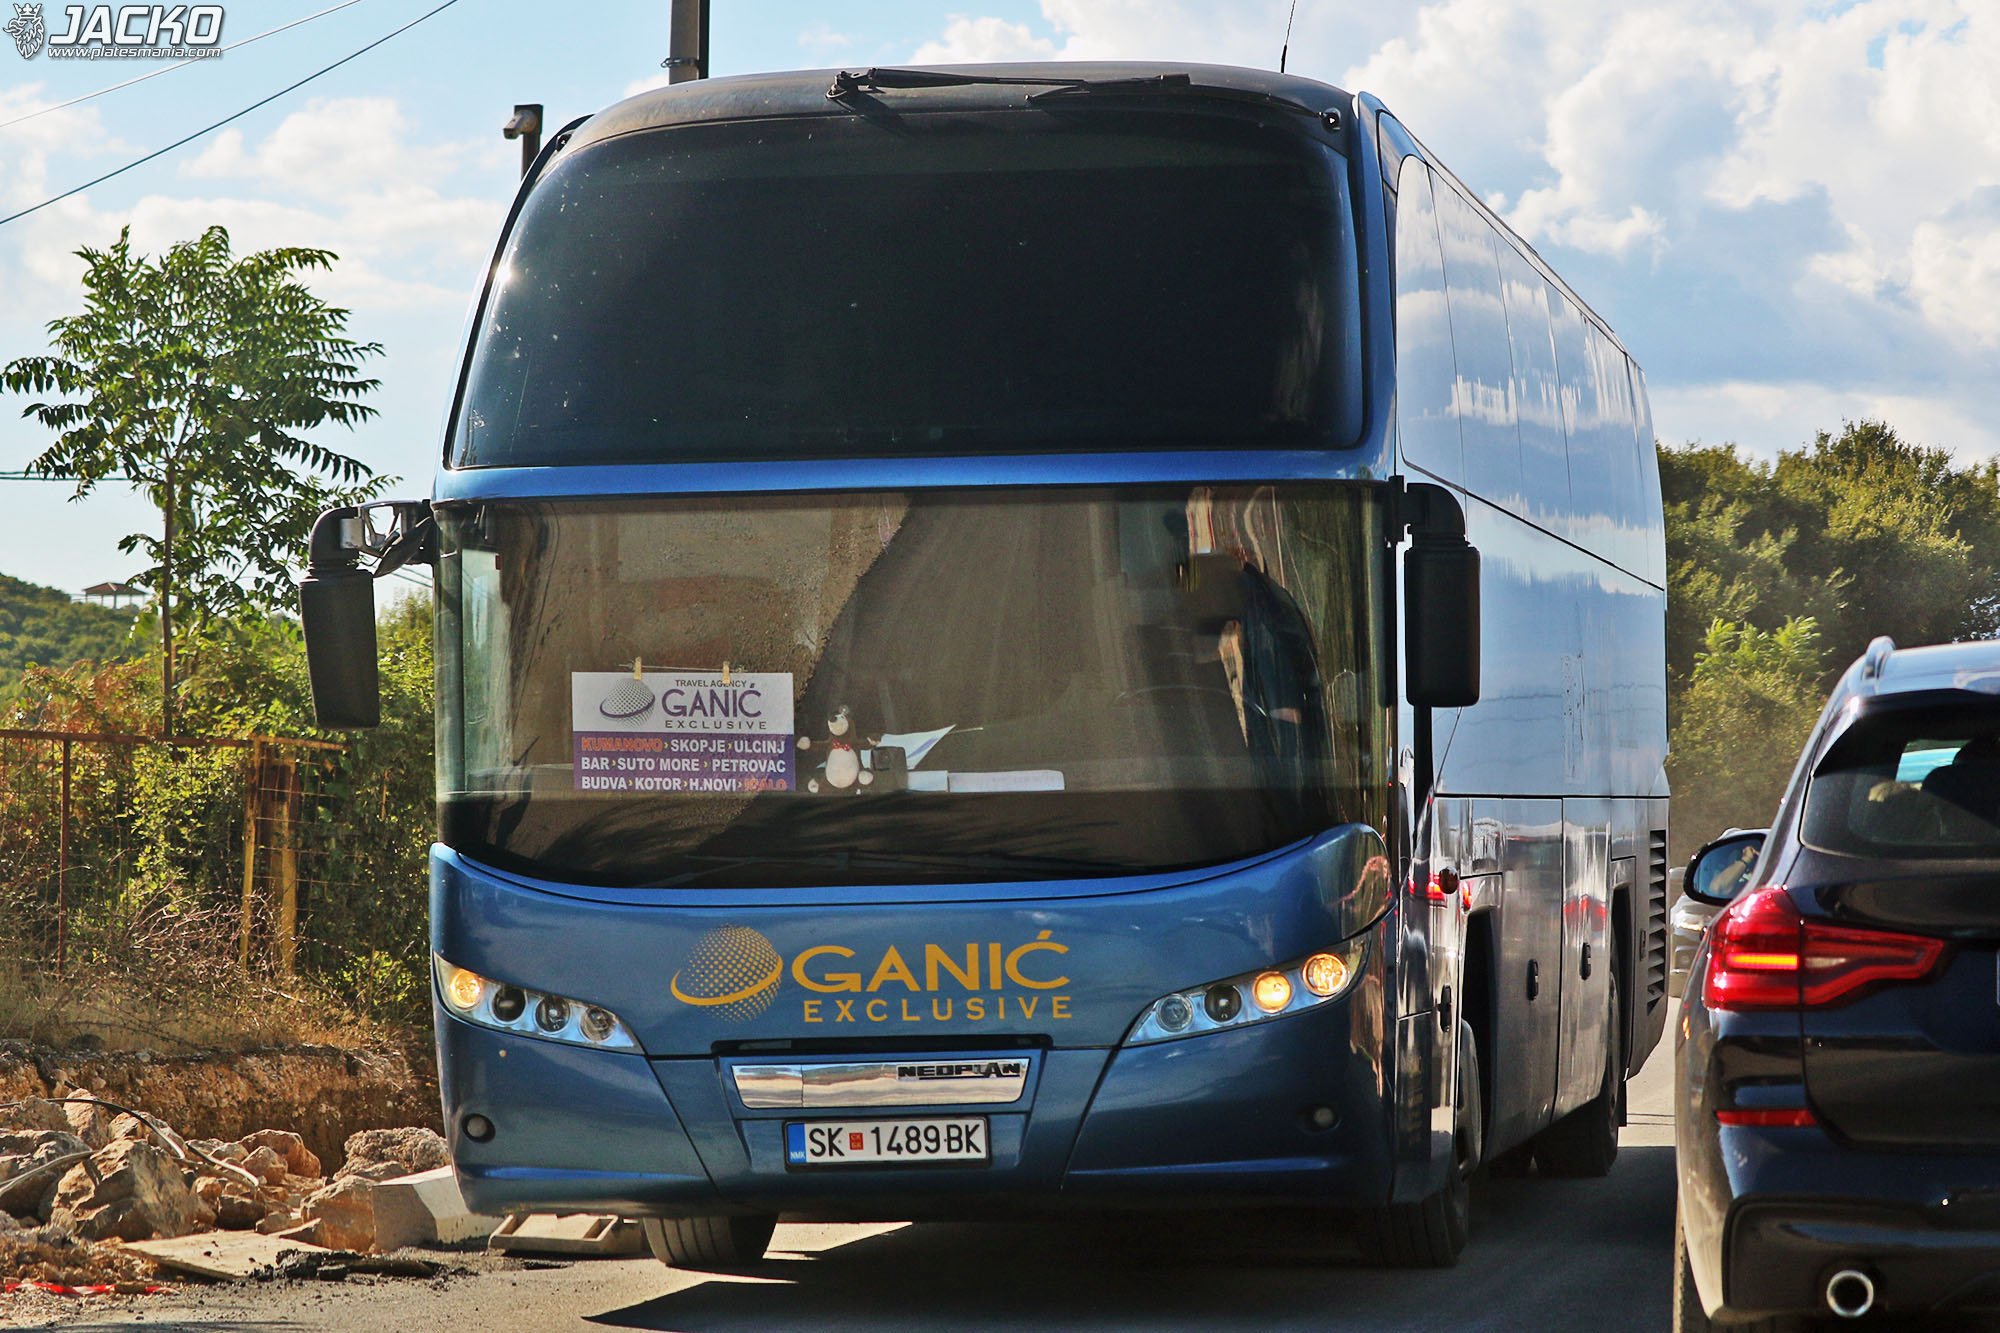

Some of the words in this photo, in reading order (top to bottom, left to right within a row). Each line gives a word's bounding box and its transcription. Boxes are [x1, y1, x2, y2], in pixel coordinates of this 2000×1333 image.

[675, 680, 708, 688] TRAVEL
[661, 683, 762, 718] GANIĆ
[665, 720, 767, 730] EXCLUSIVE
[581, 737, 663, 752] KUMANOVO
[670, 739, 726, 752] SKOPJE
[734, 740, 785, 754] ULCINJ
[581, 757, 610, 770] BAR
[617, 758, 655, 770] SUTO
[659, 758, 700, 772] MORE
[712, 759, 786, 772] PETROVAC
[581, 776, 627, 789] BUDVA
[635, 777, 682, 790] KOTOR
[689, 778, 736, 791] H.NOVI
[791, 930, 1070, 993] GANIĆ
[804, 996, 1072, 1022] EXCLUSIVE
[898, 1062, 1021, 1080] NEOPLAN
[809, 1127, 845, 1157] SK
